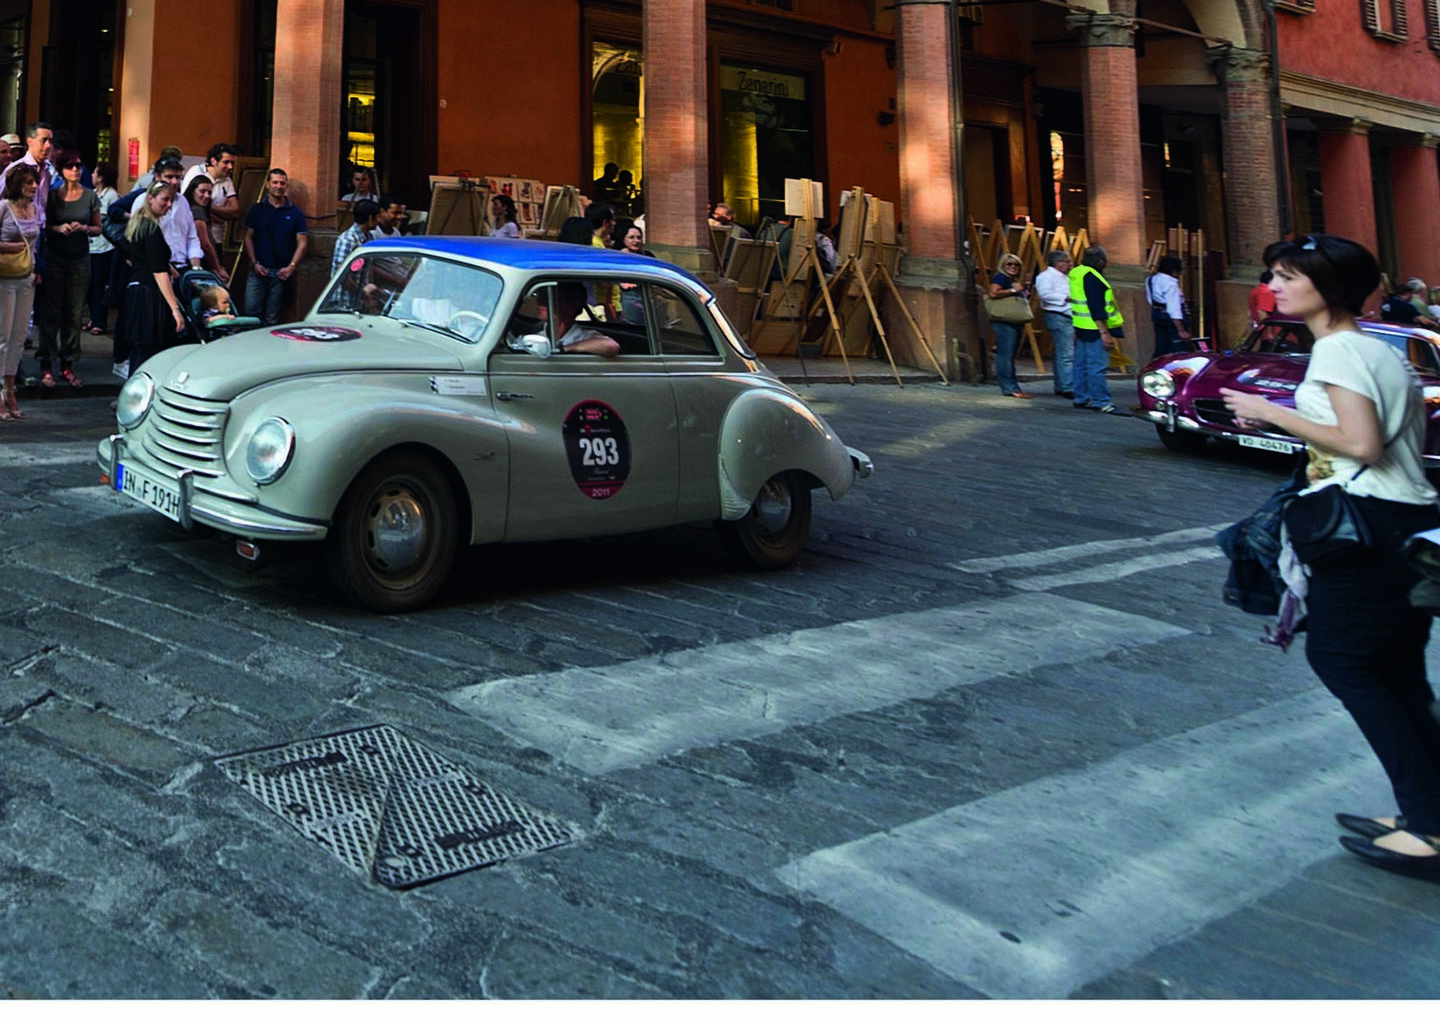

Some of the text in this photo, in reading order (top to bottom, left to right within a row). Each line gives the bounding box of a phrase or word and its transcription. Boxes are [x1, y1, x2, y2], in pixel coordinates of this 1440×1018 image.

[737, 70, 790, 97] Zanarini
[578, 437, 619, 466] 293
[142, 480, 150, 499] F
[591, 488, 611, 497] 2011
